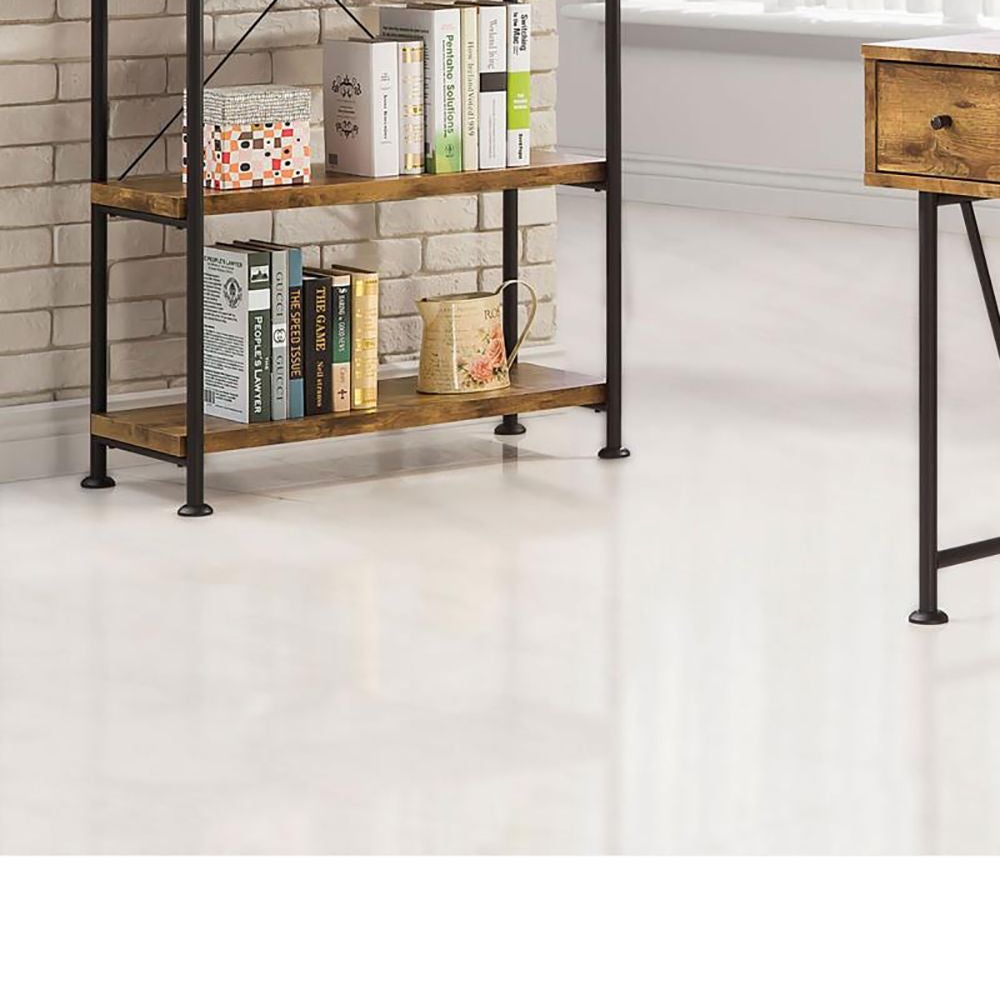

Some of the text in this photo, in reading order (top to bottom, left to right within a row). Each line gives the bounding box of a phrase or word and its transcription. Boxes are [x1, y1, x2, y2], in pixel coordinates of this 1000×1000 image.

[467, 41, 475, 60] How
[520, 14, 528, 51] Switching
[446, 34, 456, 134] Pentaho Solutions
[467, 92, 475, 116] Voted
[467, 116, 475, 137] 1989
[275, 271, 283, 317] GUCCI
[290, 289, 301, 377] THE SPEED ISSUE
[315, 286, 326, 352] THE GAME
[254, 316, 263, 413] PEOPLE'S LAWYER
[276, 355, 284, 401] GUCCI
[316, 360, 324, 377] Neil
